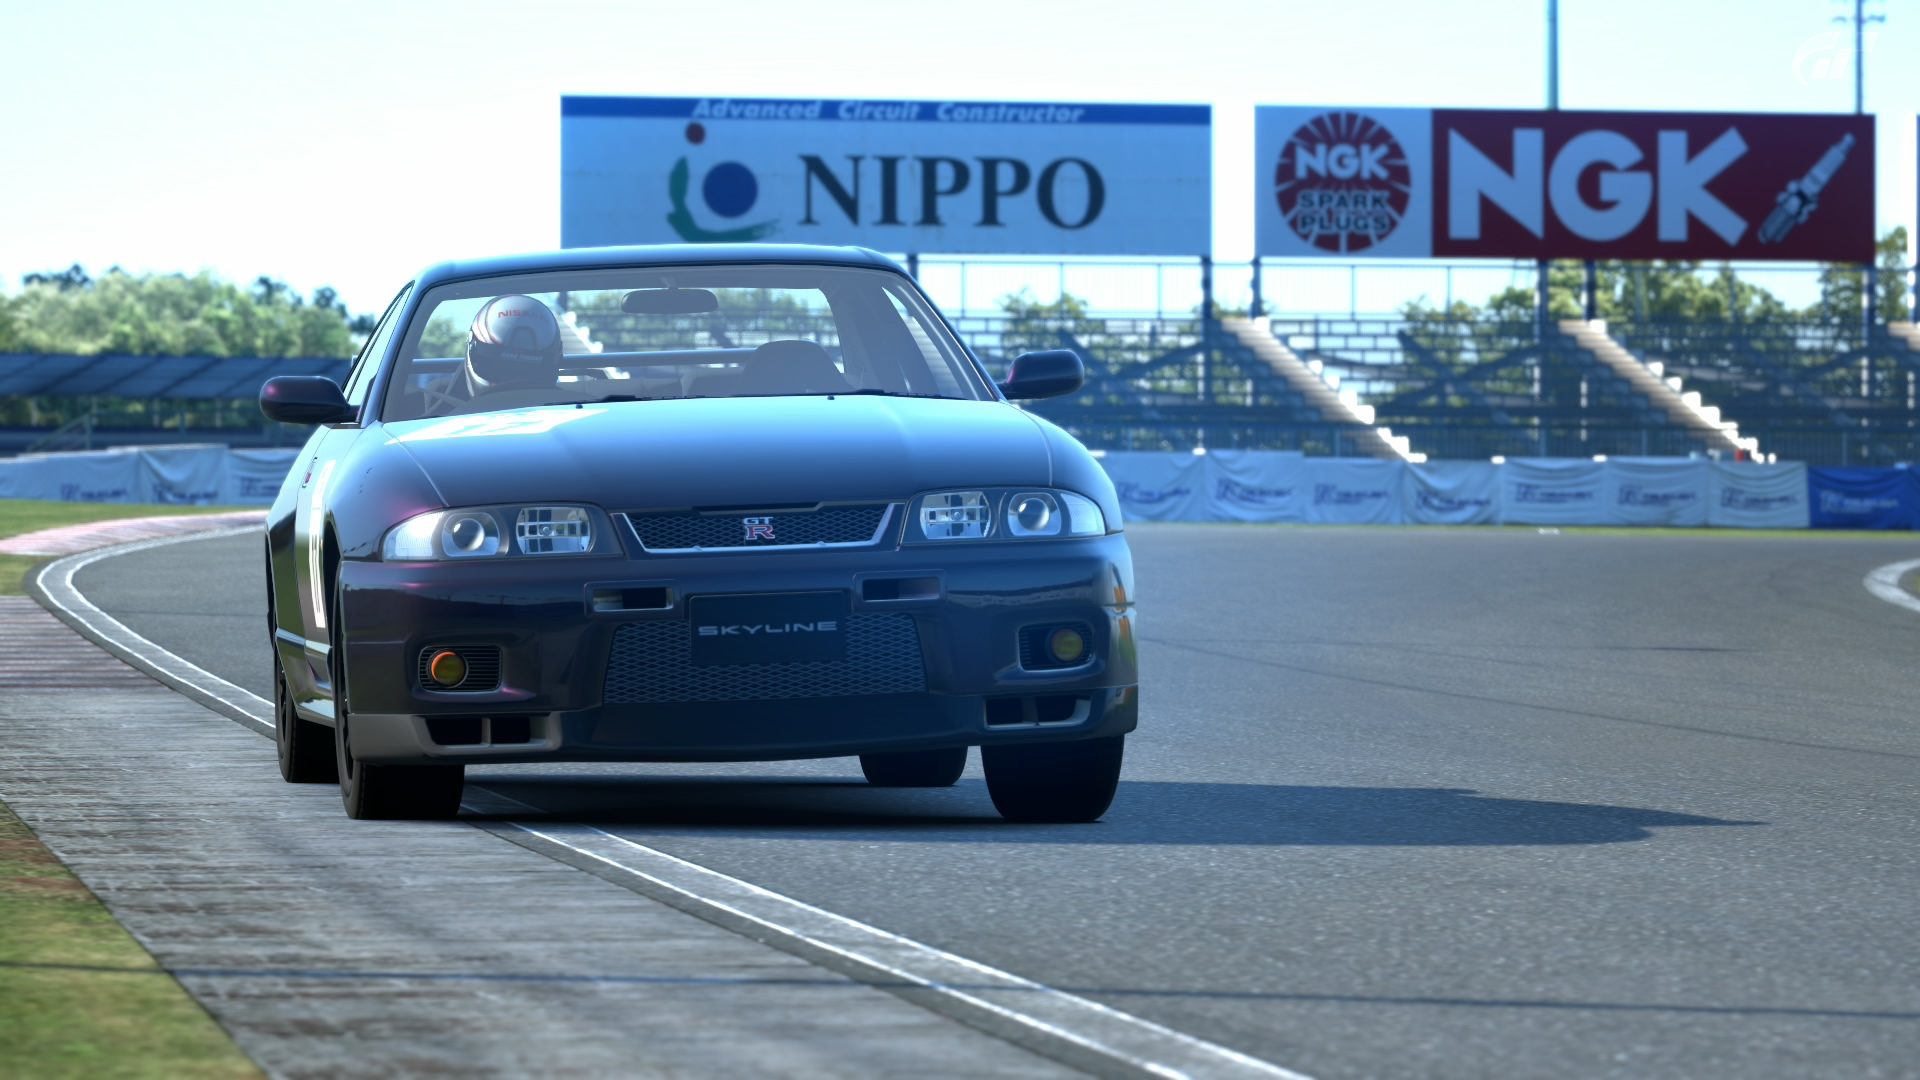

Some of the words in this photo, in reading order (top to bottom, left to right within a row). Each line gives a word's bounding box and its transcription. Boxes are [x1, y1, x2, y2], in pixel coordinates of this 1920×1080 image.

[692, 98, 823, 119] Advanced
[838, 100, 920, 121] Circuit
[935, 102, 1085, 124] Constructor
[1295, 143, 1390, 180] NGK
[796, 153, 1107, 230] NIPPO
[1448, 126, 1750, 247] NGK
[1300, 191, 1388, 209] SPARK
[1300, 213, 1388, 232] PLUGS
[743, 516, 774, 525] GT
[745, 524, 776, 540] R
[698, 621, 838, 636] SKYLINE
